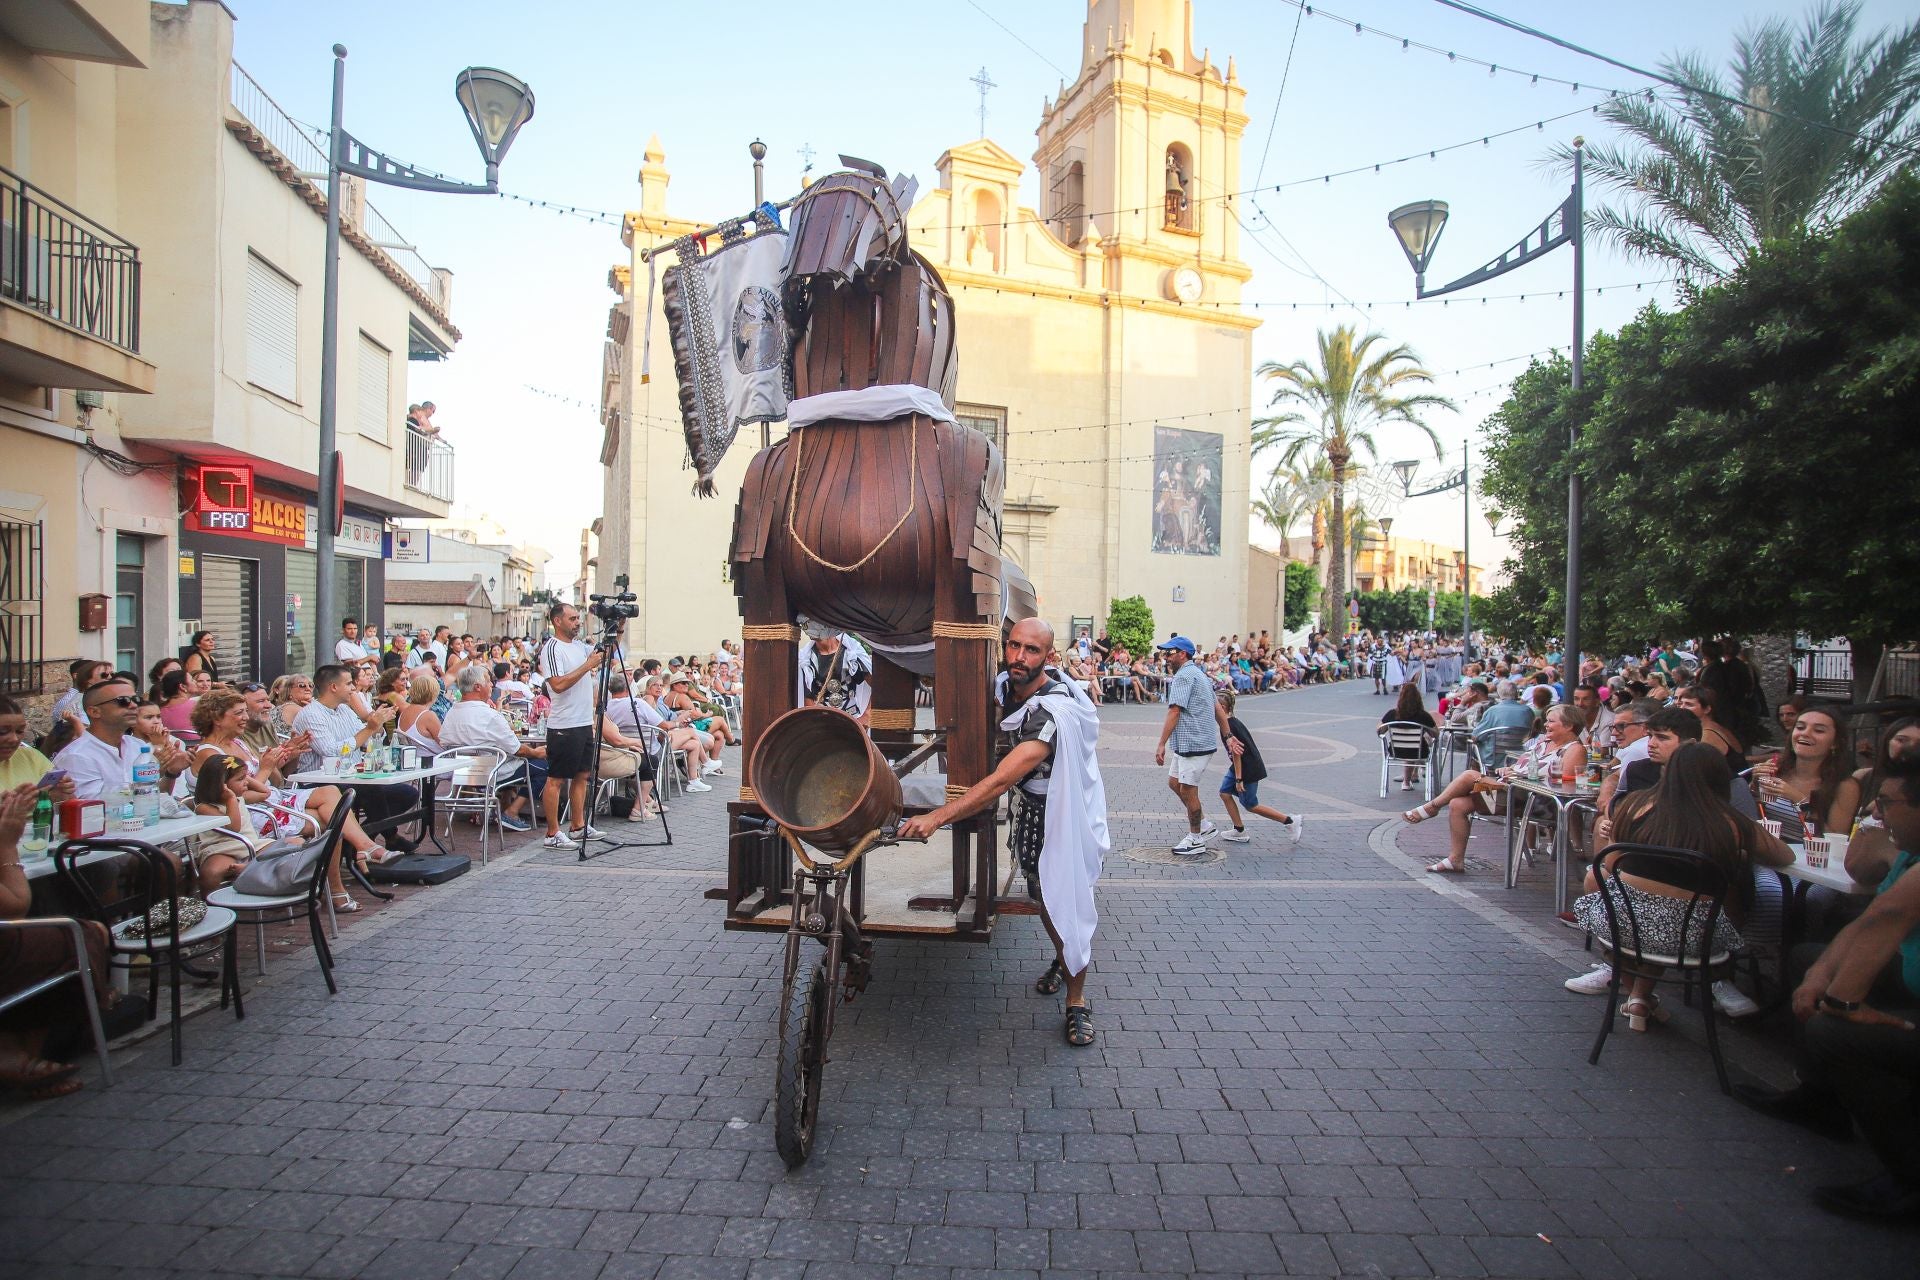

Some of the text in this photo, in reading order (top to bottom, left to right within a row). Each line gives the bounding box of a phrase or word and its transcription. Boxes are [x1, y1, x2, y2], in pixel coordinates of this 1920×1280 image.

[758, 288, 782, 312] MINE
[210, 511, 250, 529] PRO
[252, 497, 305, 532] BACOS
